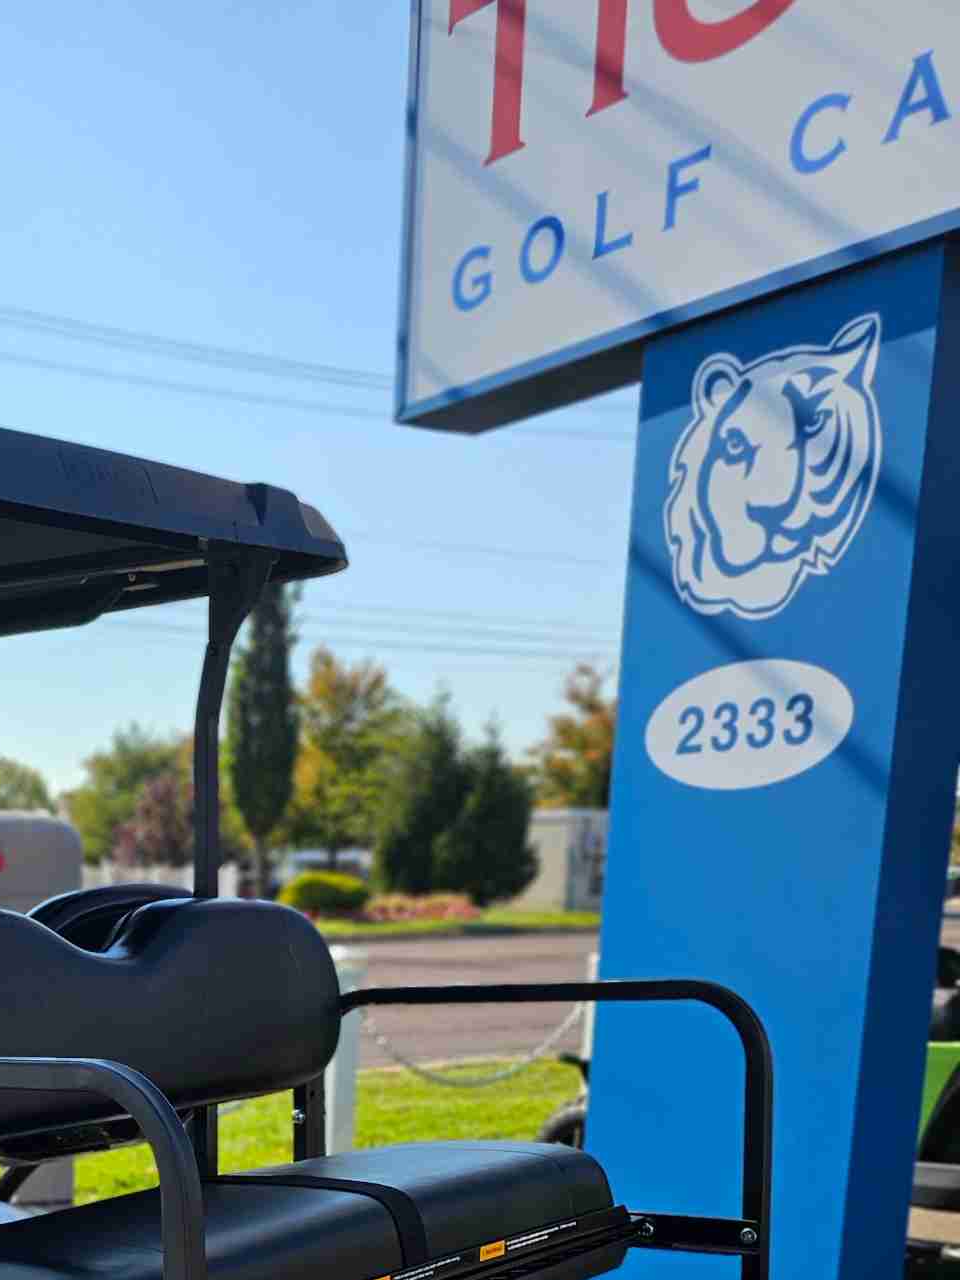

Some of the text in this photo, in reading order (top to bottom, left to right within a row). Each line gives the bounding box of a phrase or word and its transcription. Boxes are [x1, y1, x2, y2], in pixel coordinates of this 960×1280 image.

[451, 48, 951, 312] GOLF CA
[675, 693, 814, 755] 2333
